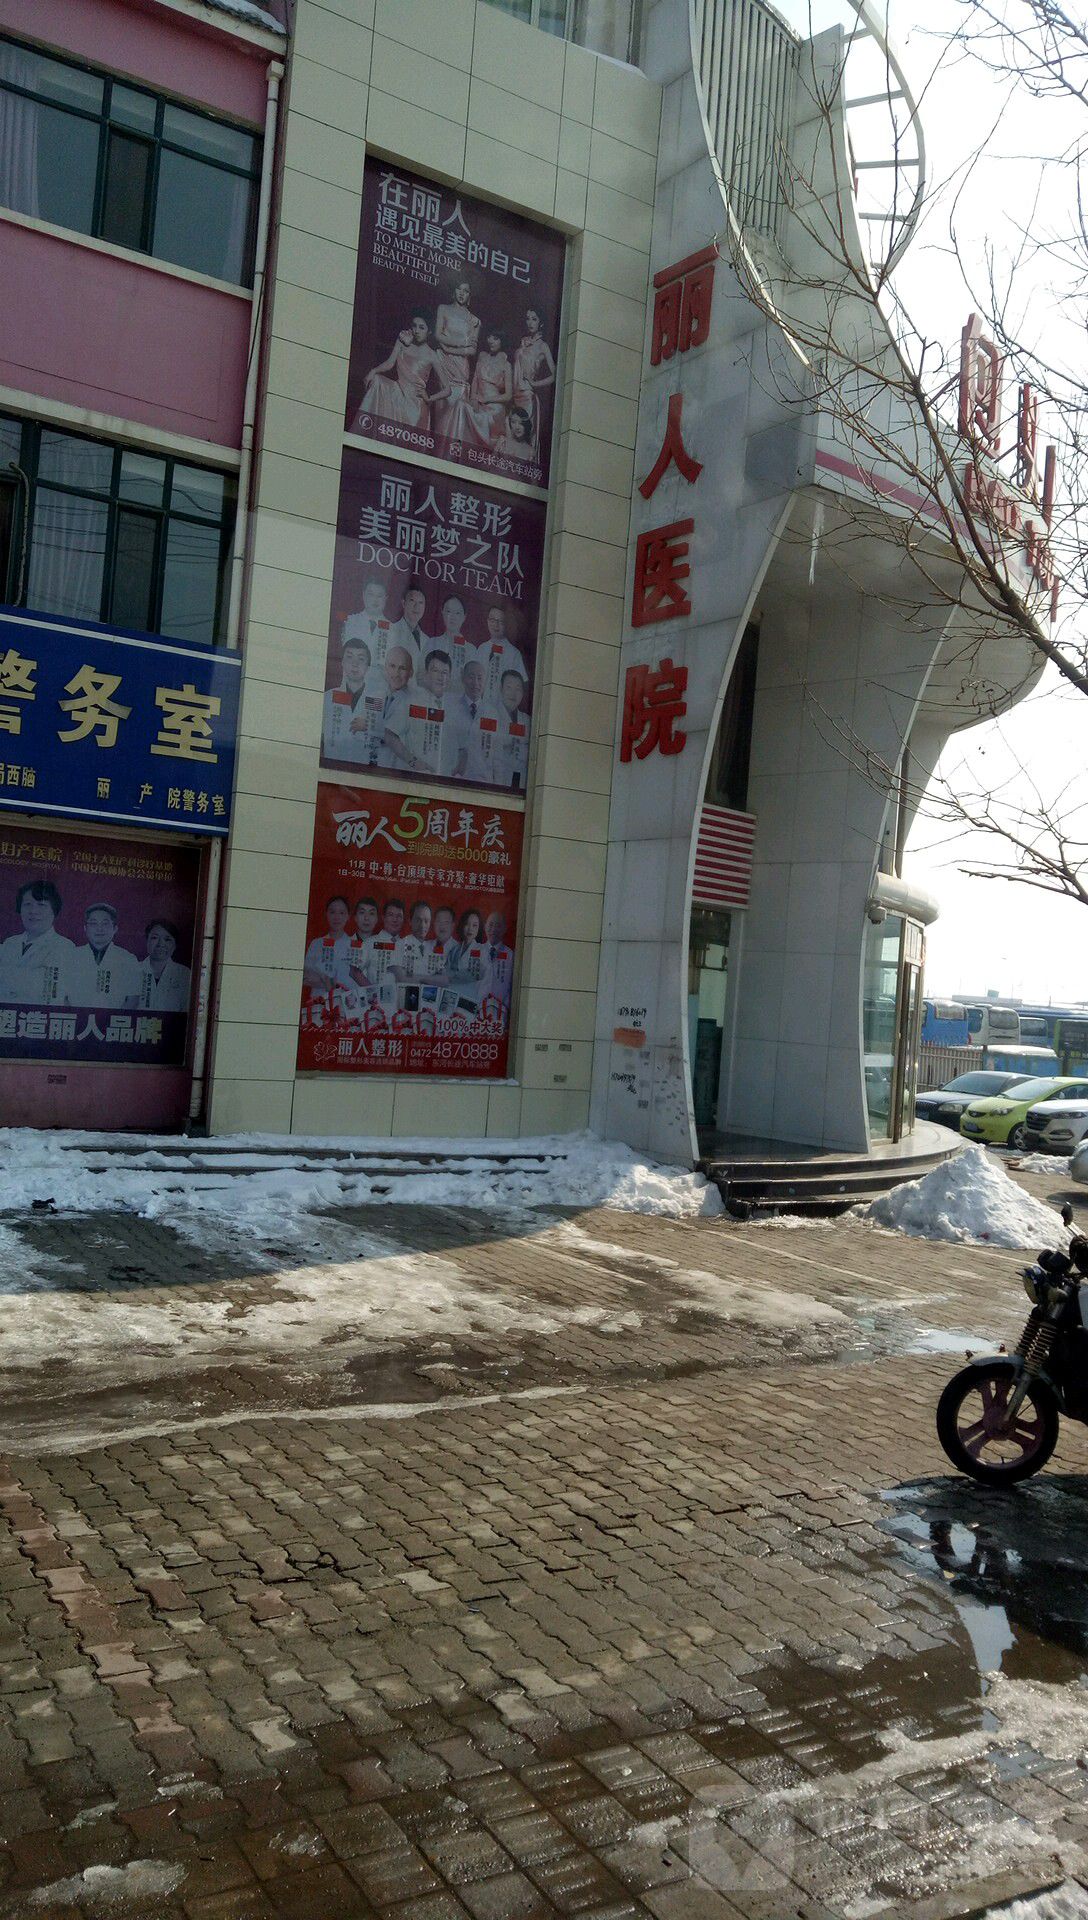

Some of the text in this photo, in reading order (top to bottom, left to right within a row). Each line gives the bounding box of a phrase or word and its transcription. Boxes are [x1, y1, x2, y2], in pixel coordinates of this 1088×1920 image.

[378, 172, 472, 237] 在丽人
[372, 242, 441, 277] BEAUTIFUL
[373, 229, 463, 272] TO MEET MORE
[375, 203, 531, 284] 遇见最美的自己
[371, 255, 441, 287] BEAUTY ITSELF
[377, 423, 435, 449] 4870888
[380, 473, 513, 537] 丽人整形
[619, 244, 720, 763] 丽人医院
[358, 506, 525, 578] 美丽梦之队
[356, 541, 525, 600] DOCTOR TEAM
[331, 797, 506, 853] 丽人5周年庆
[406, 840, 512, 867] 到院即送5000豪礼
[337, 1037, 403, 1058] 丽人整形
[436, 1017, 504, 1037] 100%中大奖
